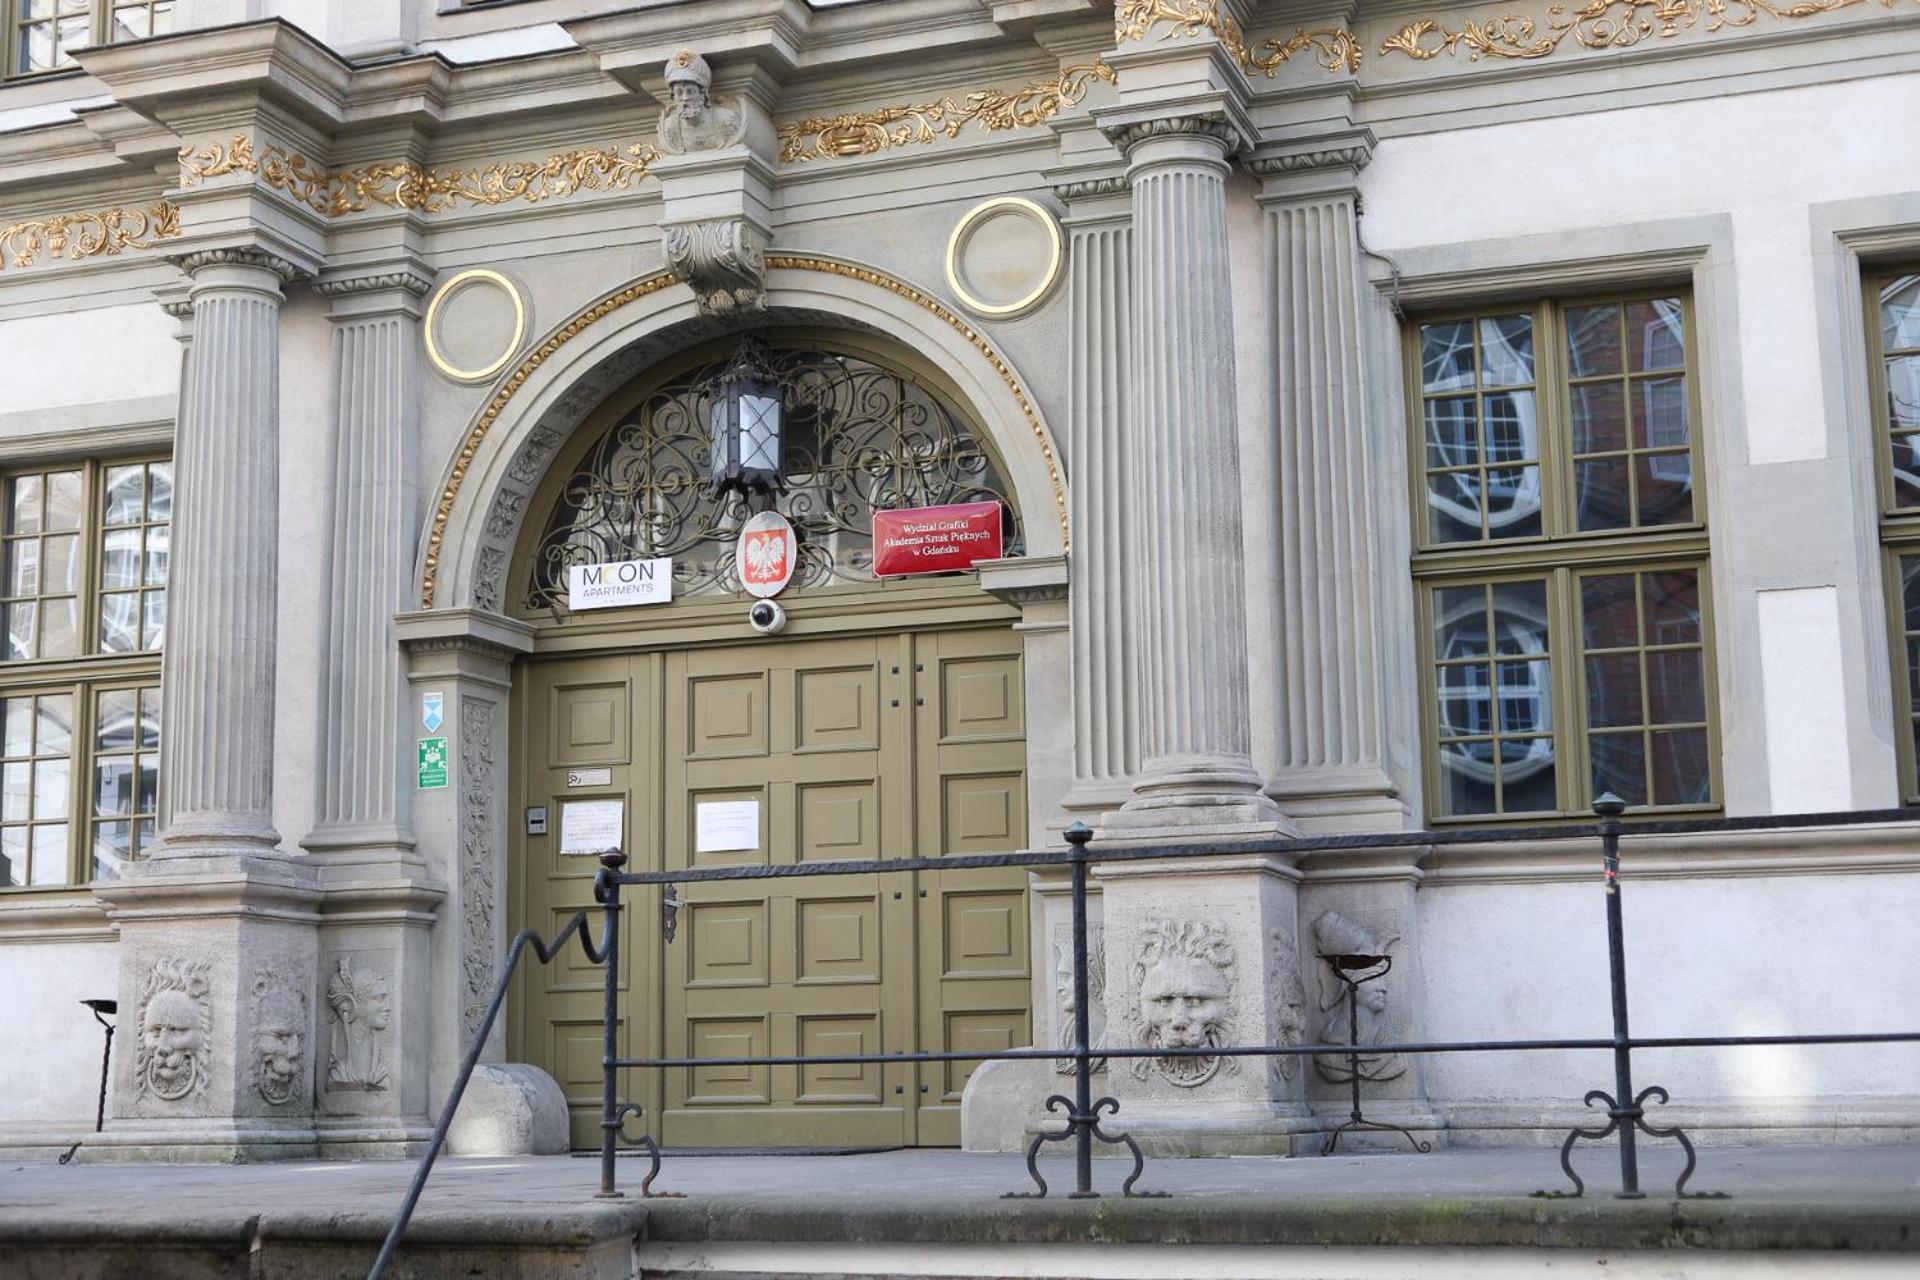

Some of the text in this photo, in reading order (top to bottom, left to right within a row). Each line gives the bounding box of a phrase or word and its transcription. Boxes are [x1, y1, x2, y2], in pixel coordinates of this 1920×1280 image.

[938, 520, 969, 531] Grafiki
[883, 530, 991, 547] Akademia Sztuk Pięknych
[583, 583, 653, 597] APARTMENTS
